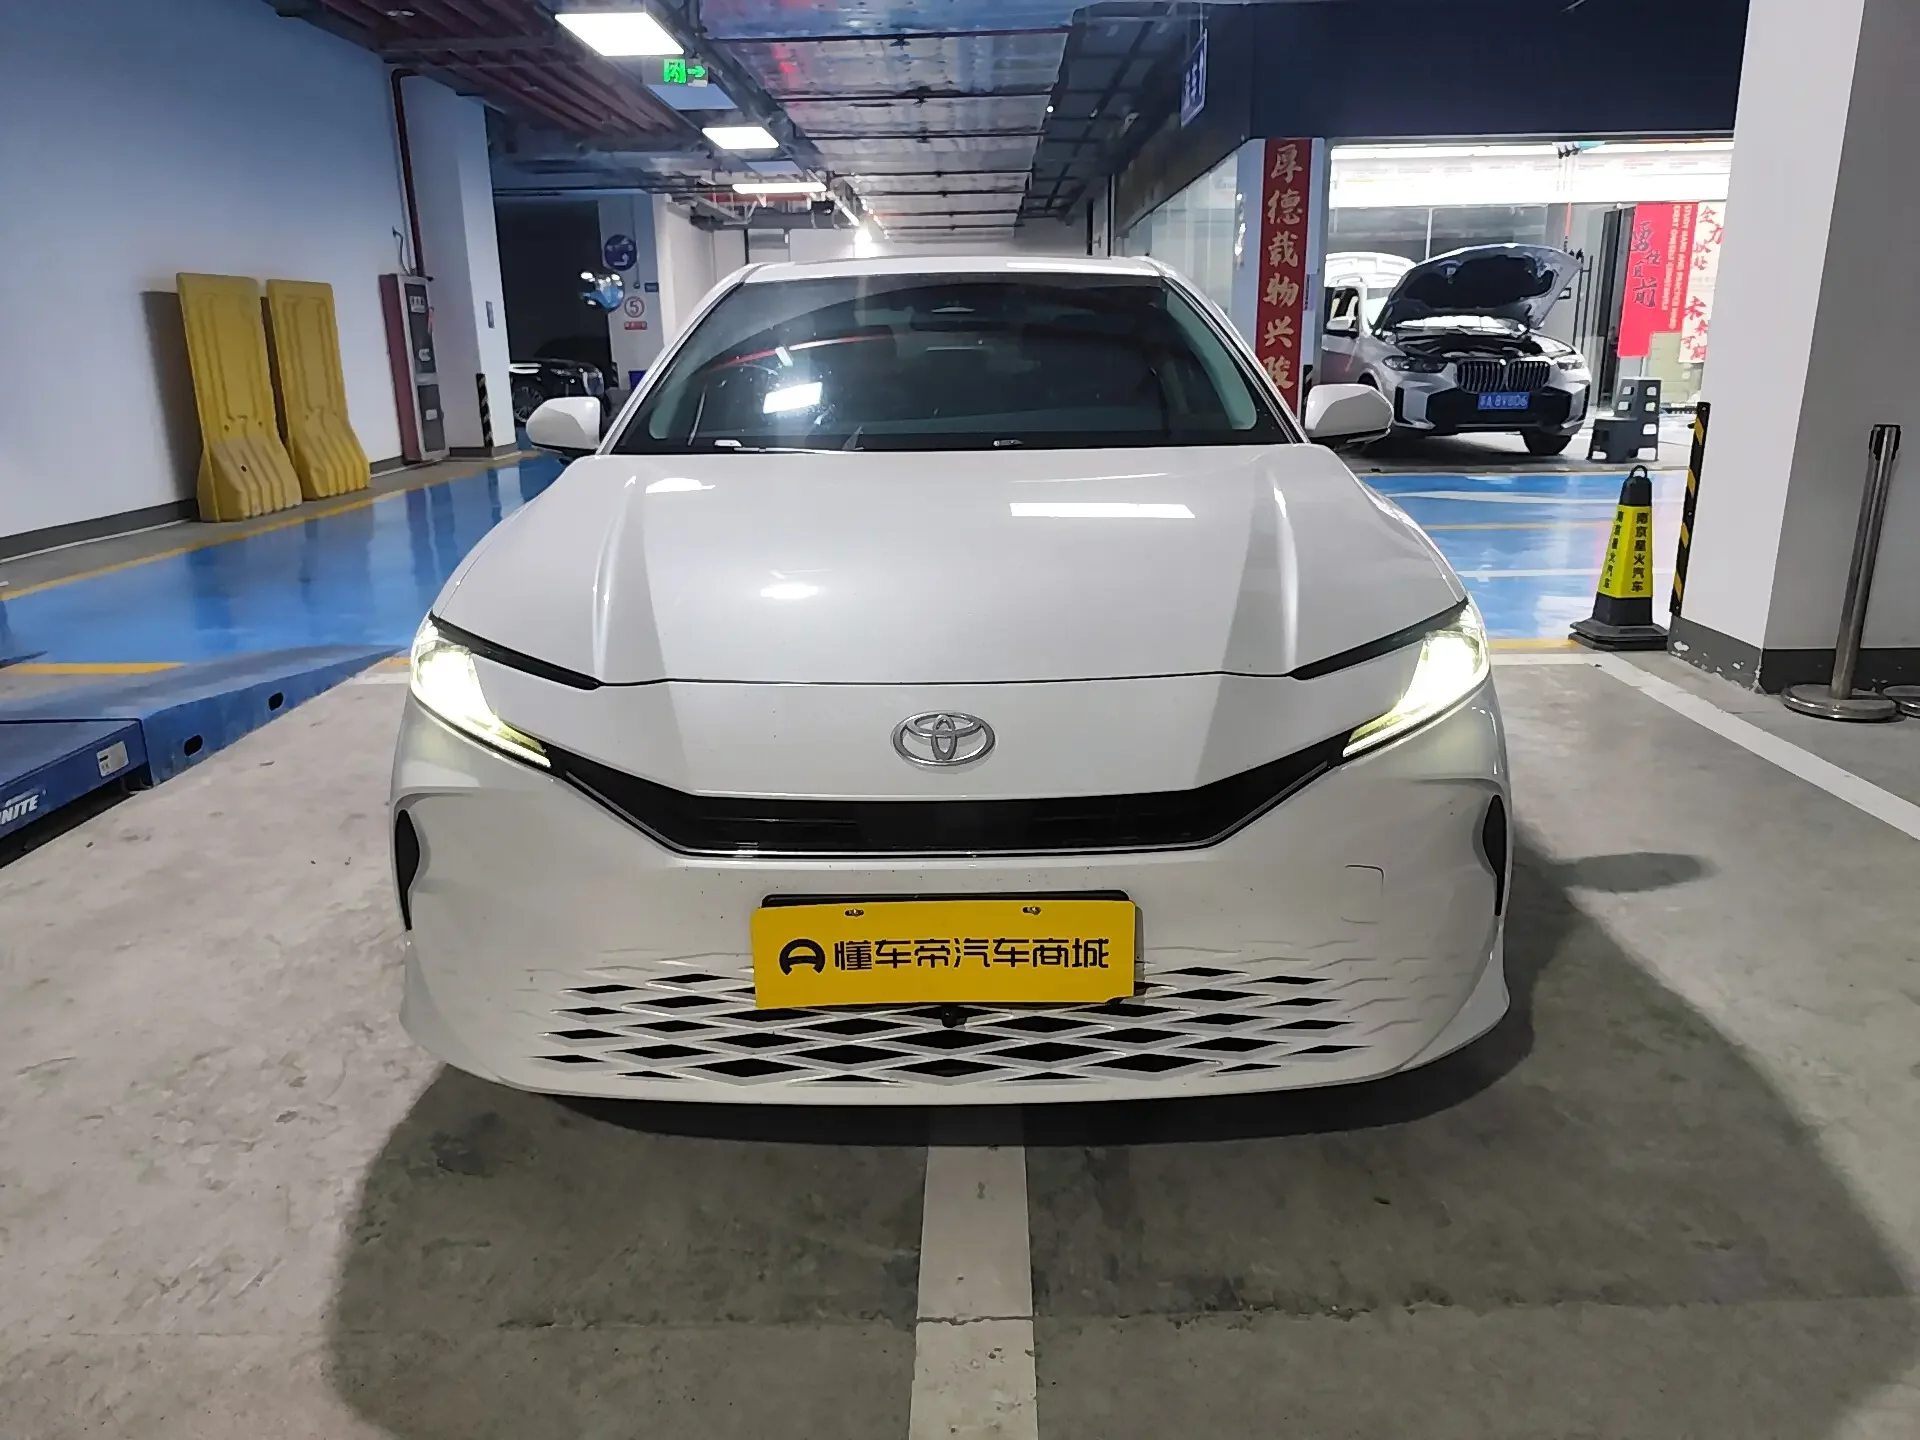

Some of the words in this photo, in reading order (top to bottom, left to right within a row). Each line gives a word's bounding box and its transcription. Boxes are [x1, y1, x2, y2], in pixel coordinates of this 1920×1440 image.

[1682, 204, 1692, 228] STUDY
[1631, 512, 1649, 592] 南京星火汽车
[0, 794, 39, 825] NITE
[834, 937, 1109, 971] 懂车帝汽车商城
